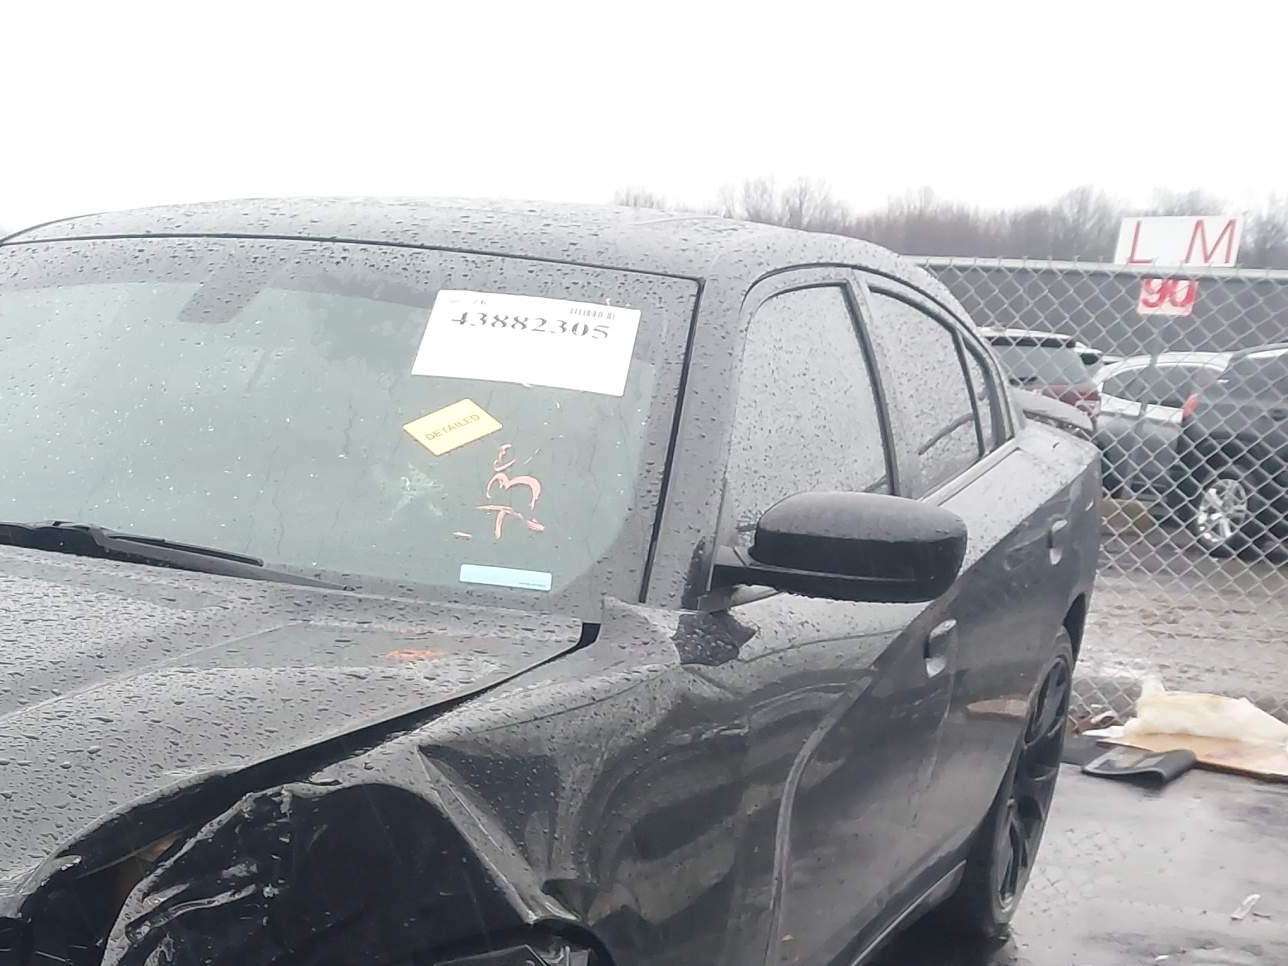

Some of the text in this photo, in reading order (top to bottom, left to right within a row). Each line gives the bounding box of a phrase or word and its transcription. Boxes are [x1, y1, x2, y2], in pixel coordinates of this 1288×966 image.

[1127, 219, 1236, 264] L M
[1142, 276, 1196, 308] 90
[451, 311, 610, 340] 43882305
[424, 412, 481, 441] DETAILED
